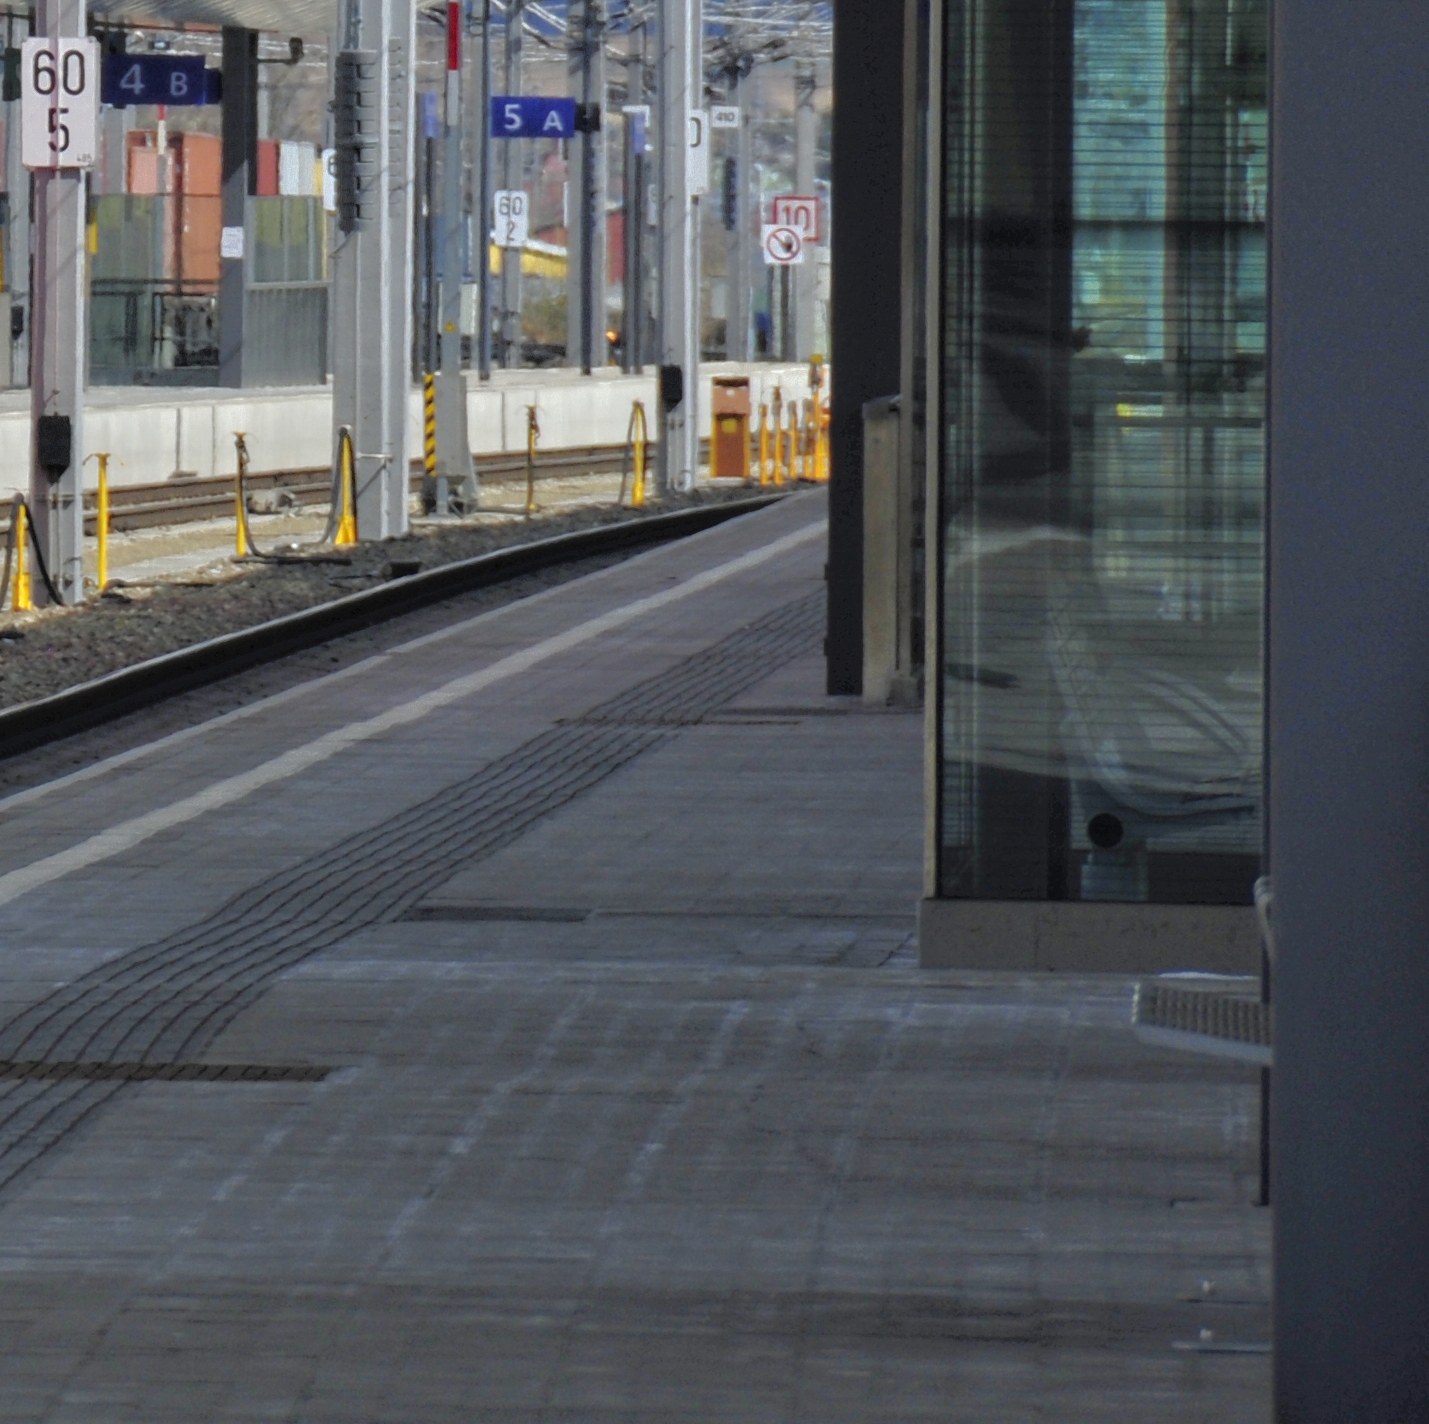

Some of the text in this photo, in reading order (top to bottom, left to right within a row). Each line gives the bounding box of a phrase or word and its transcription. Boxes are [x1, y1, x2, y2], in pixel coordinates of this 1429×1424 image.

[33, 49, 85, 96] 60
[119, 63, 188, 97] 4 B
[48, 107, 70, 153] 5
[504, 103, 564, 131] 5 A
[498, 196, 523, 216] 60
[782, 205, 811, 232] 10
[506, 221, 516, 242] 2
